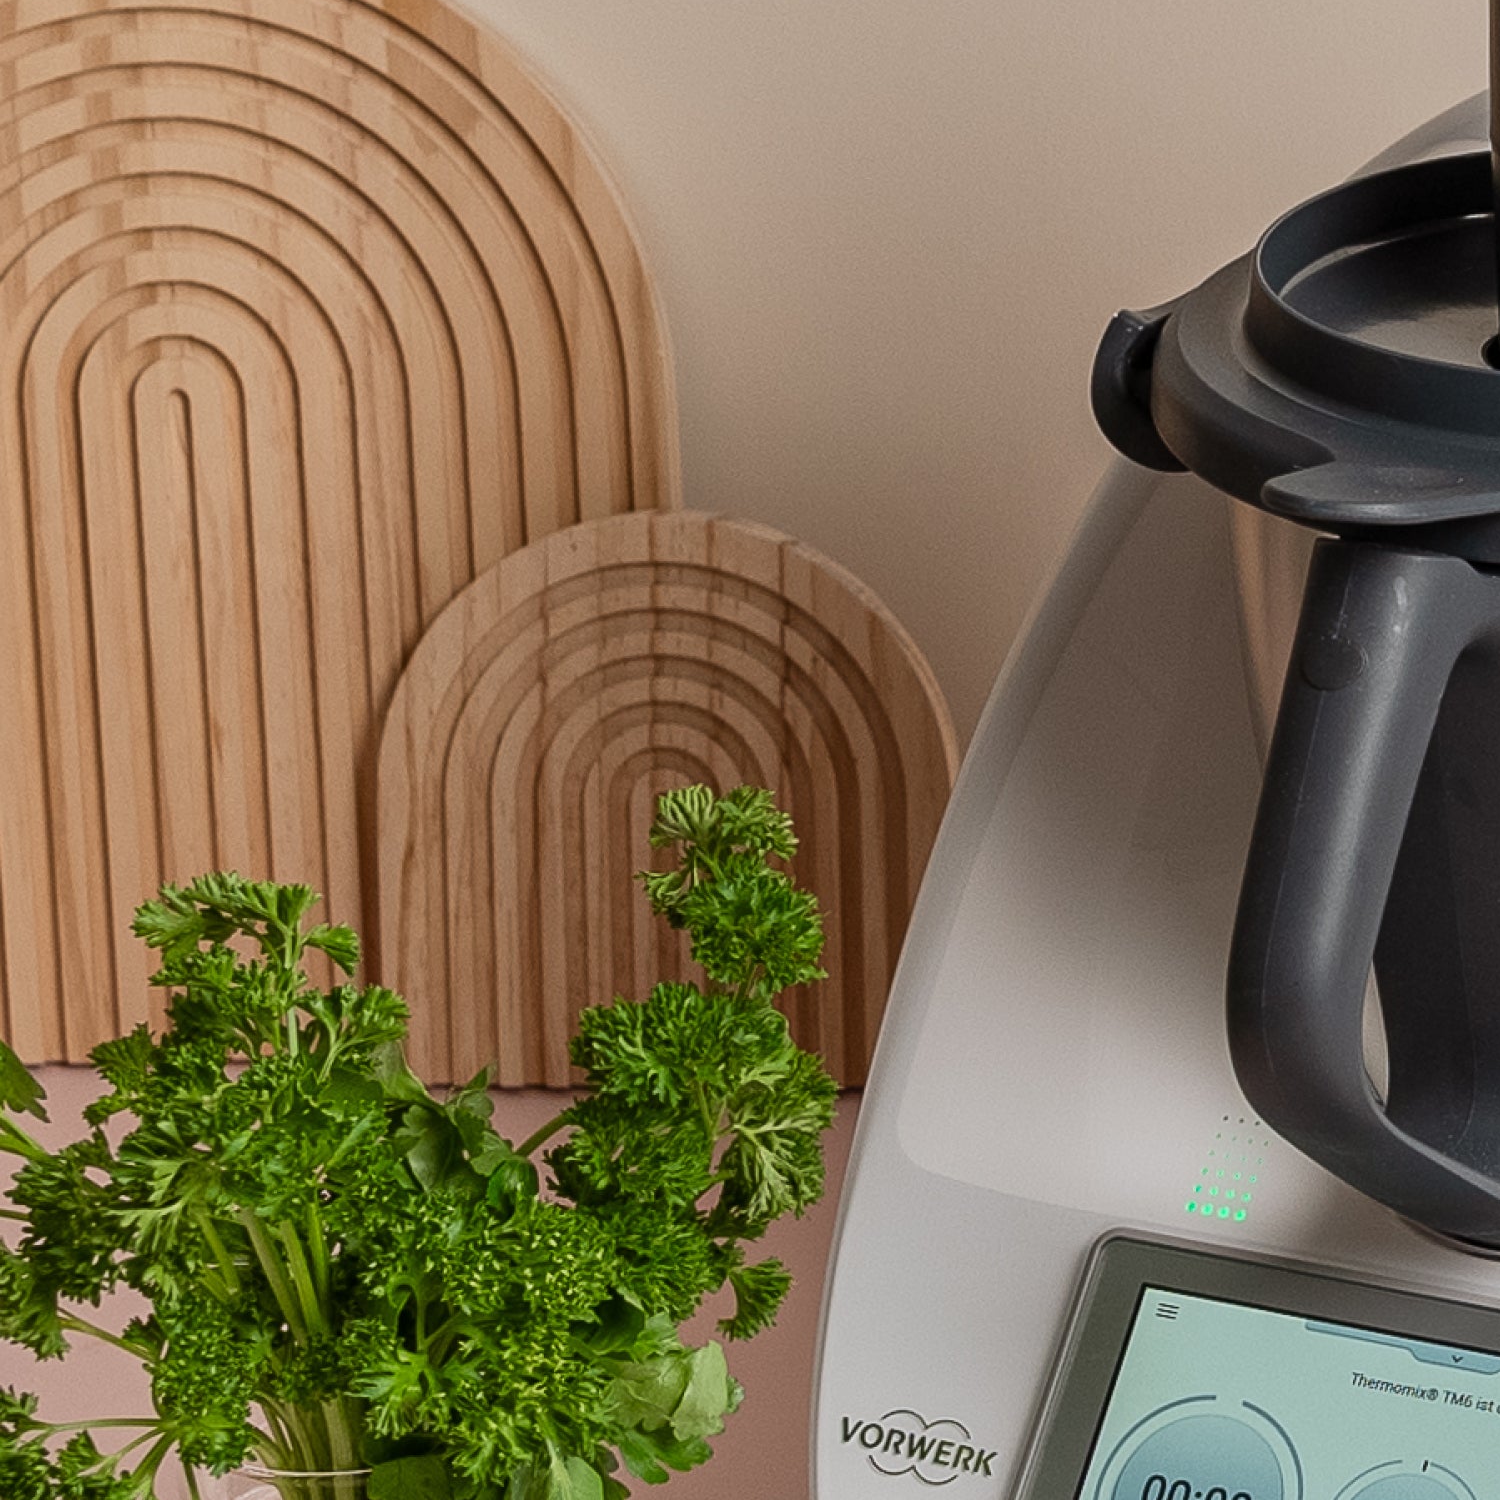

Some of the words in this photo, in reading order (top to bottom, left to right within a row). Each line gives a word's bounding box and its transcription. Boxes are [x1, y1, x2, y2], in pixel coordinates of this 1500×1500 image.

[1443, 1390, 1473, 1409] TM6
[1475, 1396, 1494, 1413] ist
[841, 1416, 999, 1476] VORWERK
